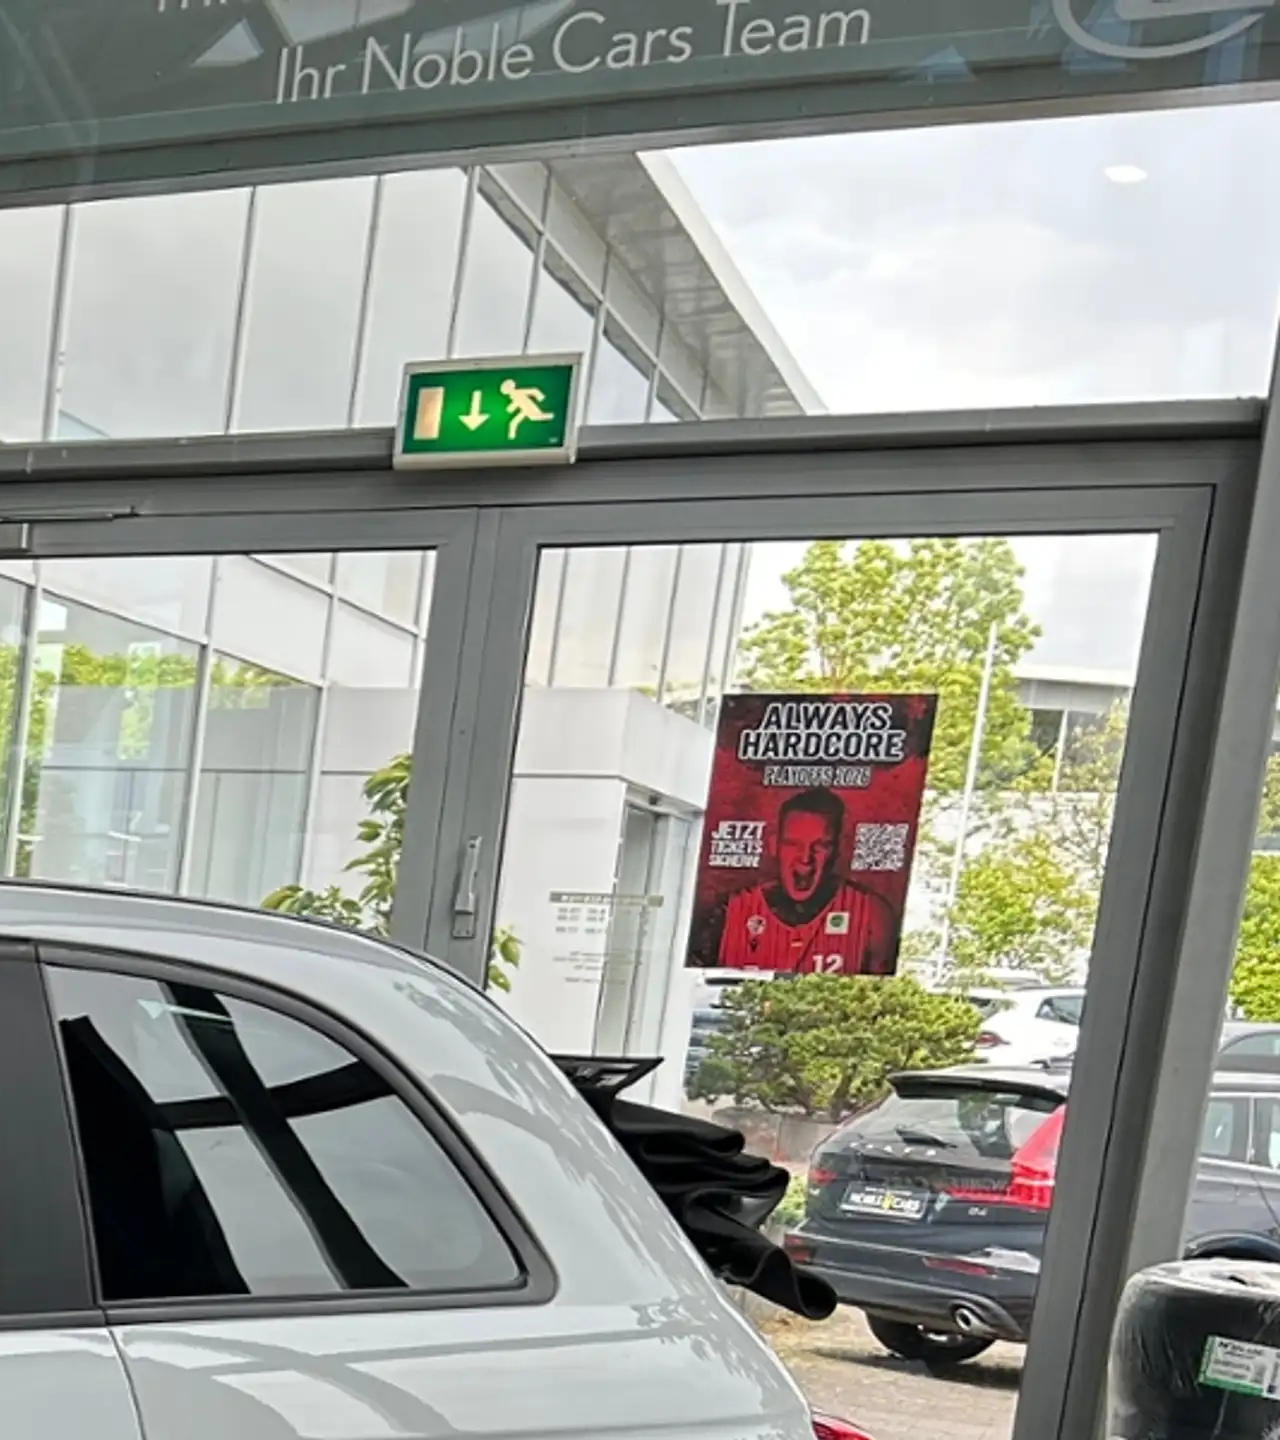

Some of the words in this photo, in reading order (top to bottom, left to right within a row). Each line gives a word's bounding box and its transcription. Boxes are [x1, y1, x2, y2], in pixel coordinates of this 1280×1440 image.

[276, 45, 346, 104] Ihr
[361, 21, 534, 94] Noble
[552, 11, 692, 73] Cars
[716, 0, 871, 57] Team
[762, 703, 893, 732] ALWAYS
[739, 730, 907, 760] HARDCORE
[763, 765, 833, 786] PLAYOFFS
[711, 820, 767, 839] JETZT
[812, 954, 844, 974] 12
